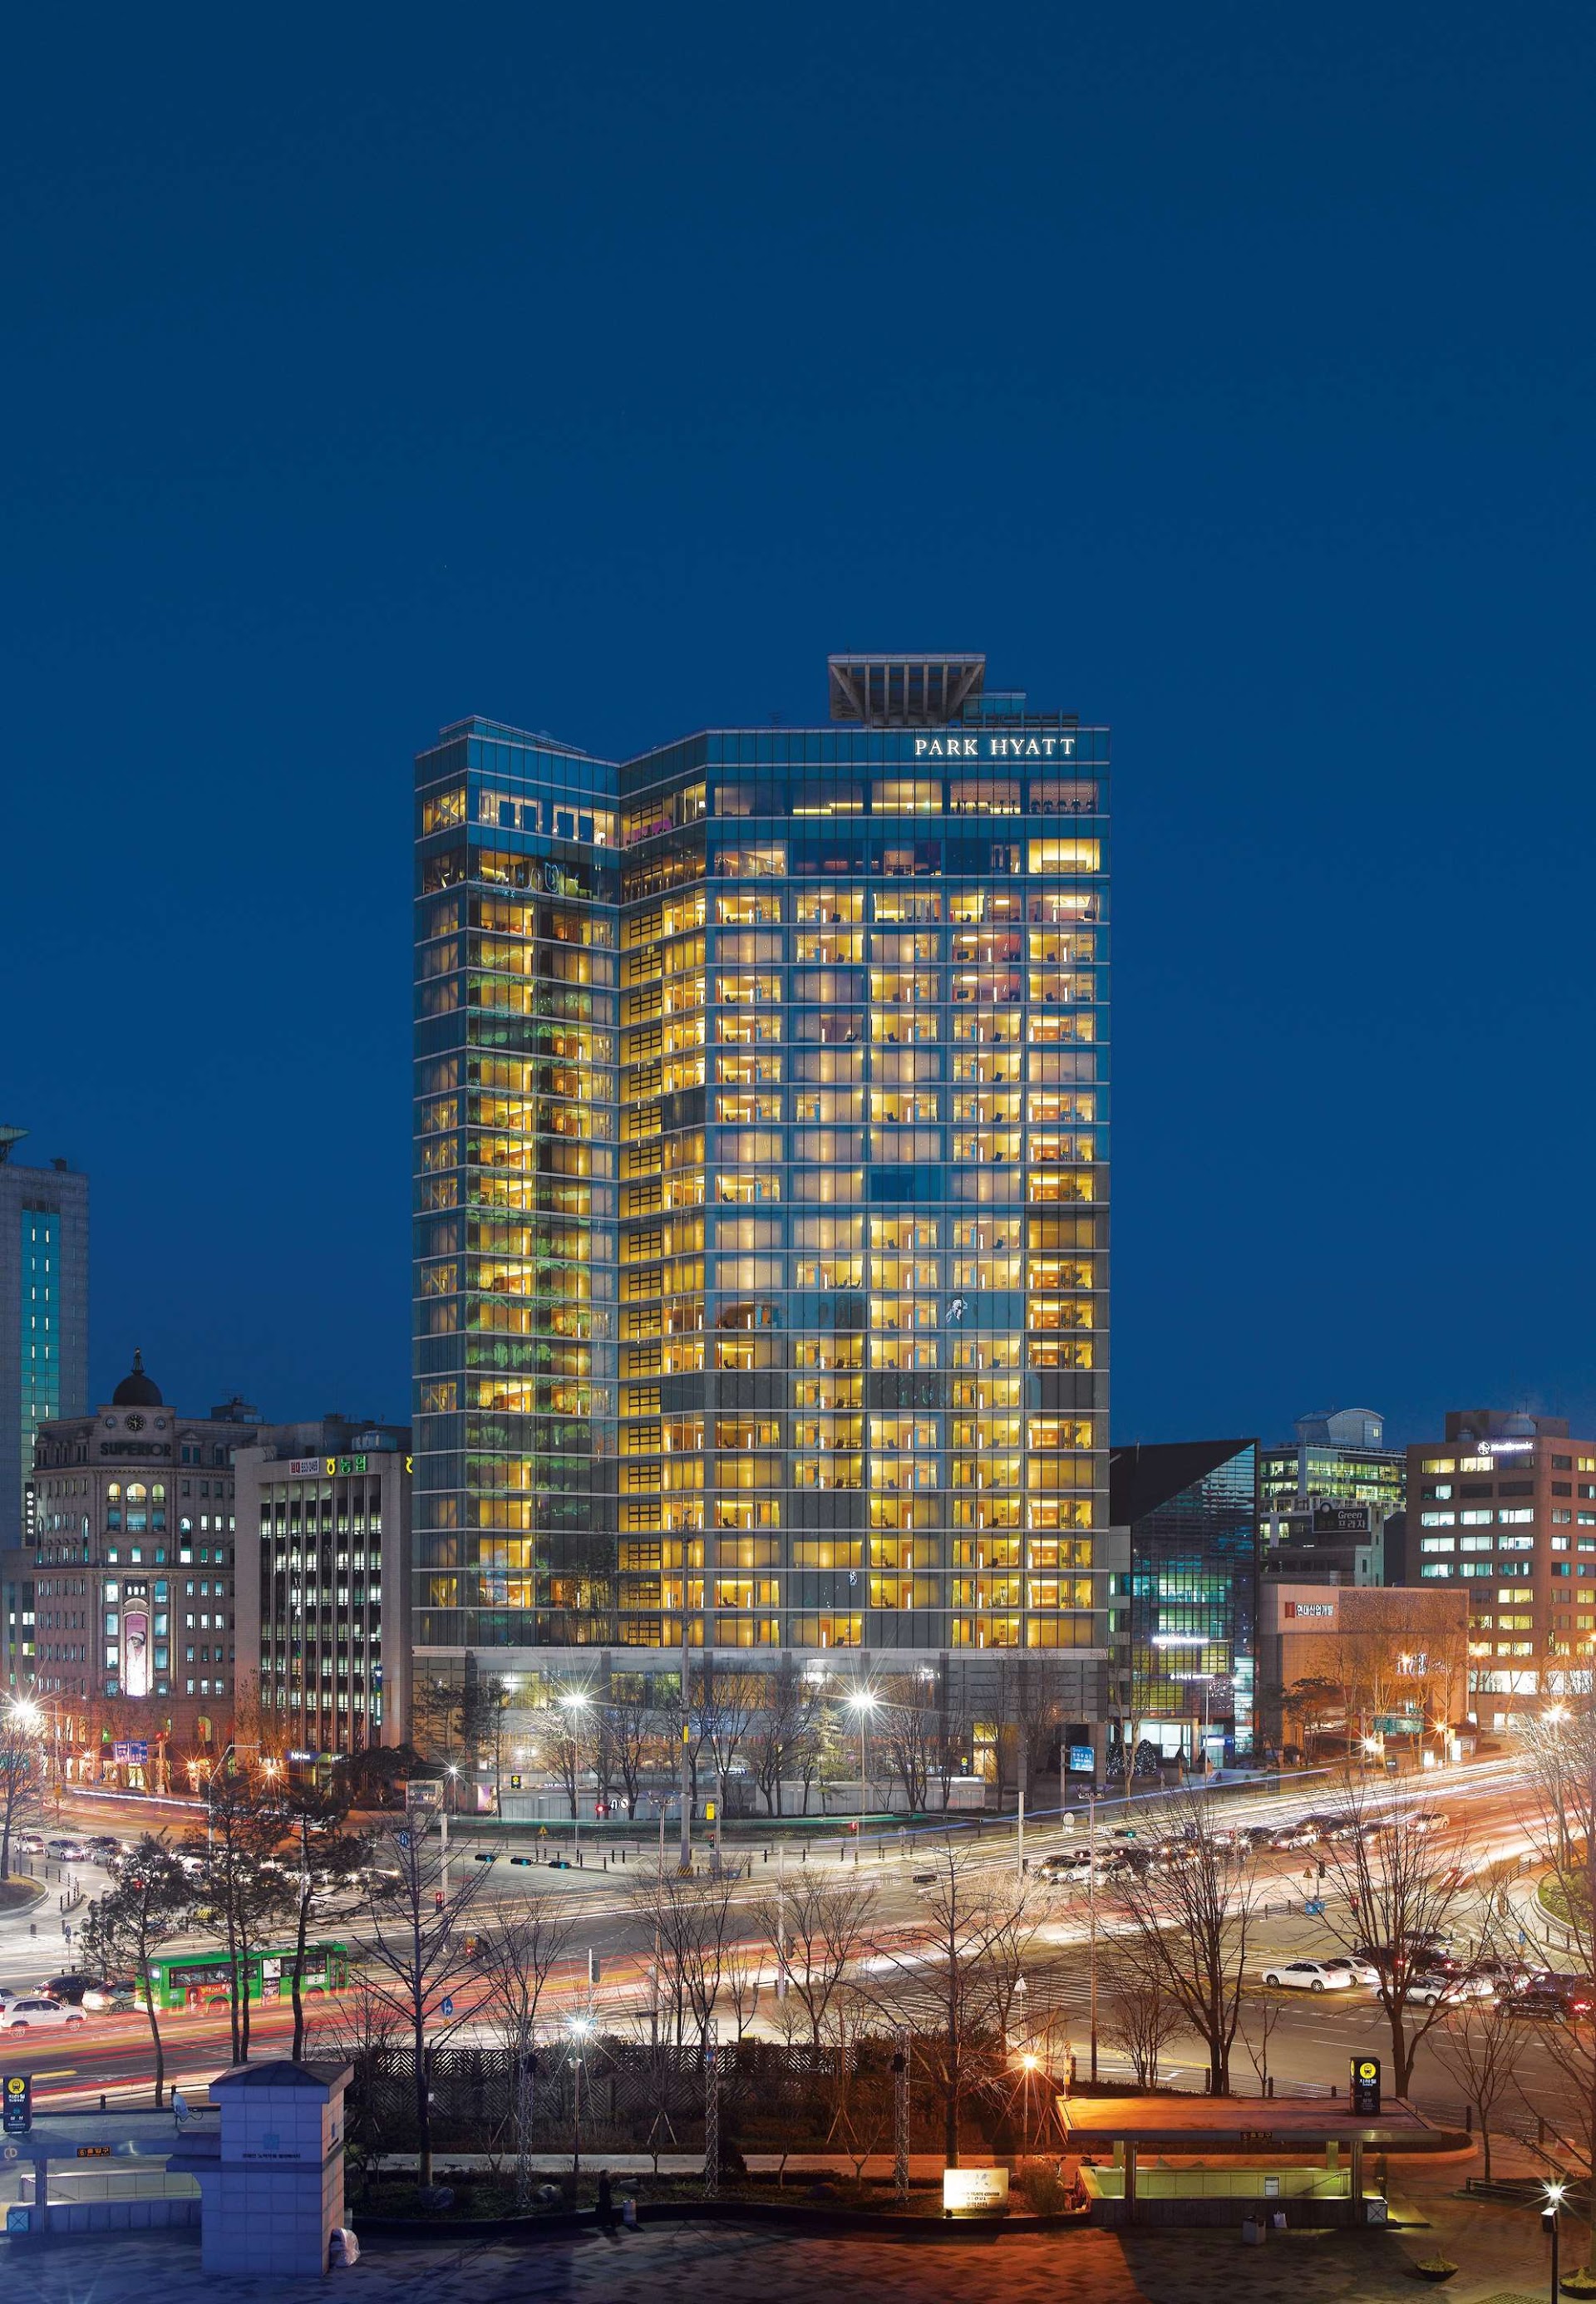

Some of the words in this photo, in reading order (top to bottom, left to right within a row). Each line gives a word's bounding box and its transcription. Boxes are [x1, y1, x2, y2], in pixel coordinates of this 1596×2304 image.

[914, 739, 978, 756] PARK
[991, 739, 1075, 755] HYATT
[101, 1442, 172, 1457] SUPERIOR
[1490, 1441, 1534, 1451] Medtronic
[341, 1455, 367, 1474] 농협
[1338, 1510, 1362, 1519] Green
[1297, 1604, 1333, 1617] 현대산업개발
[291, 1751, 303, 1760] NH
